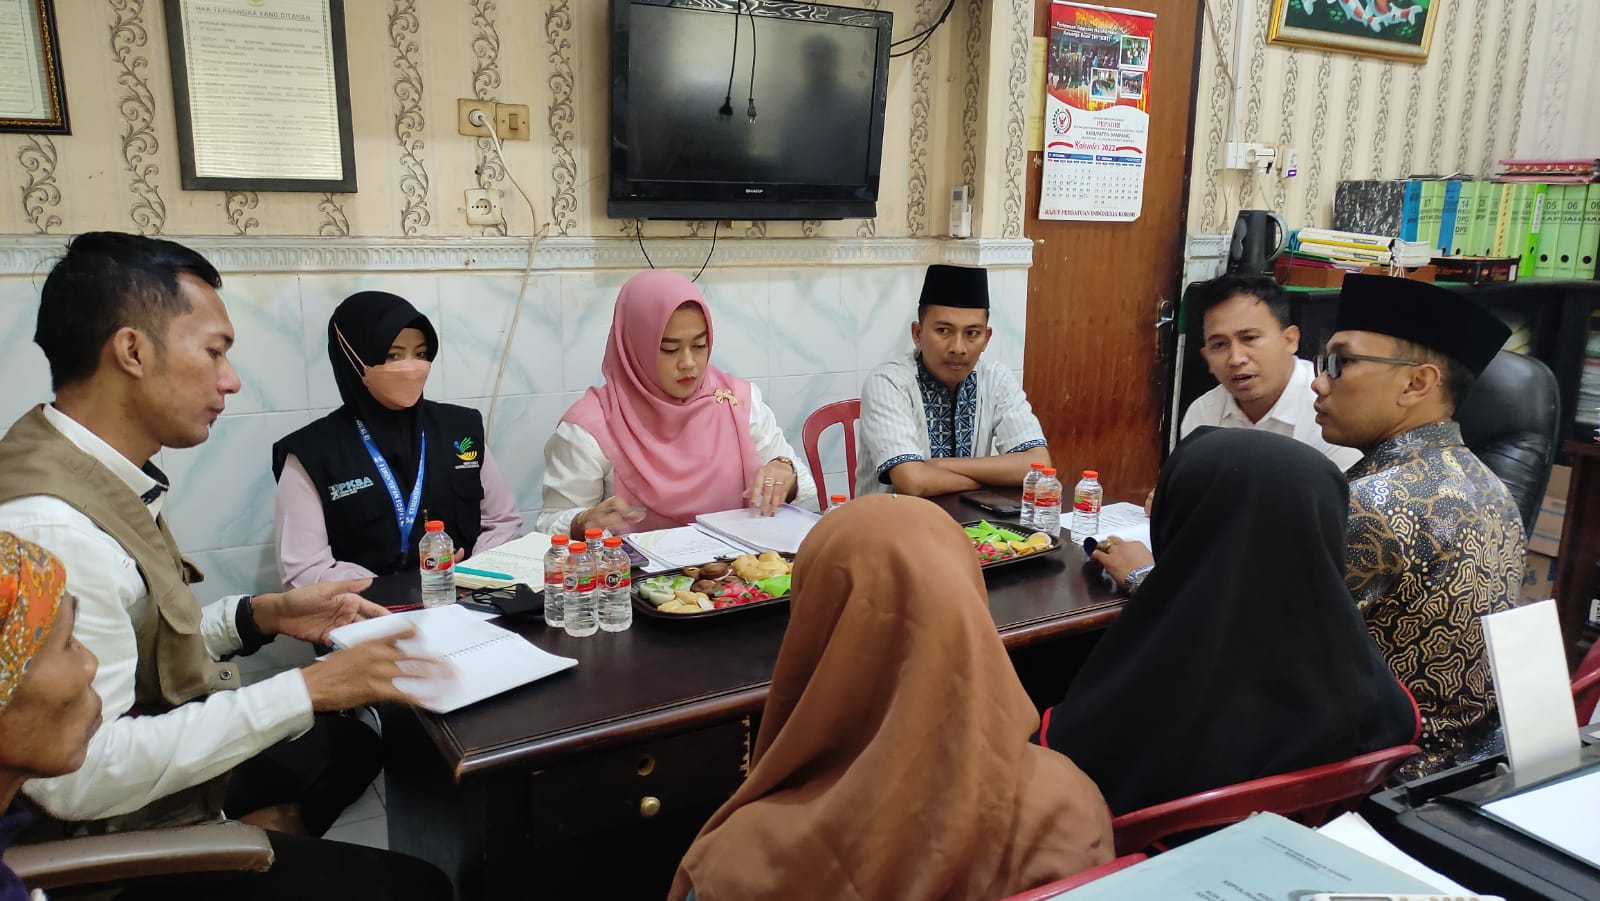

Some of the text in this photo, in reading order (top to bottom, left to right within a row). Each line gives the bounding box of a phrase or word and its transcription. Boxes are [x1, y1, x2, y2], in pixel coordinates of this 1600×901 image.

[281, 12, 311, 22] DITAHAN
[1102, 144, 1116, 152] 2022
[1546, 201, 1557, 210] 05
[1567, 201, 1578, 210] 06
